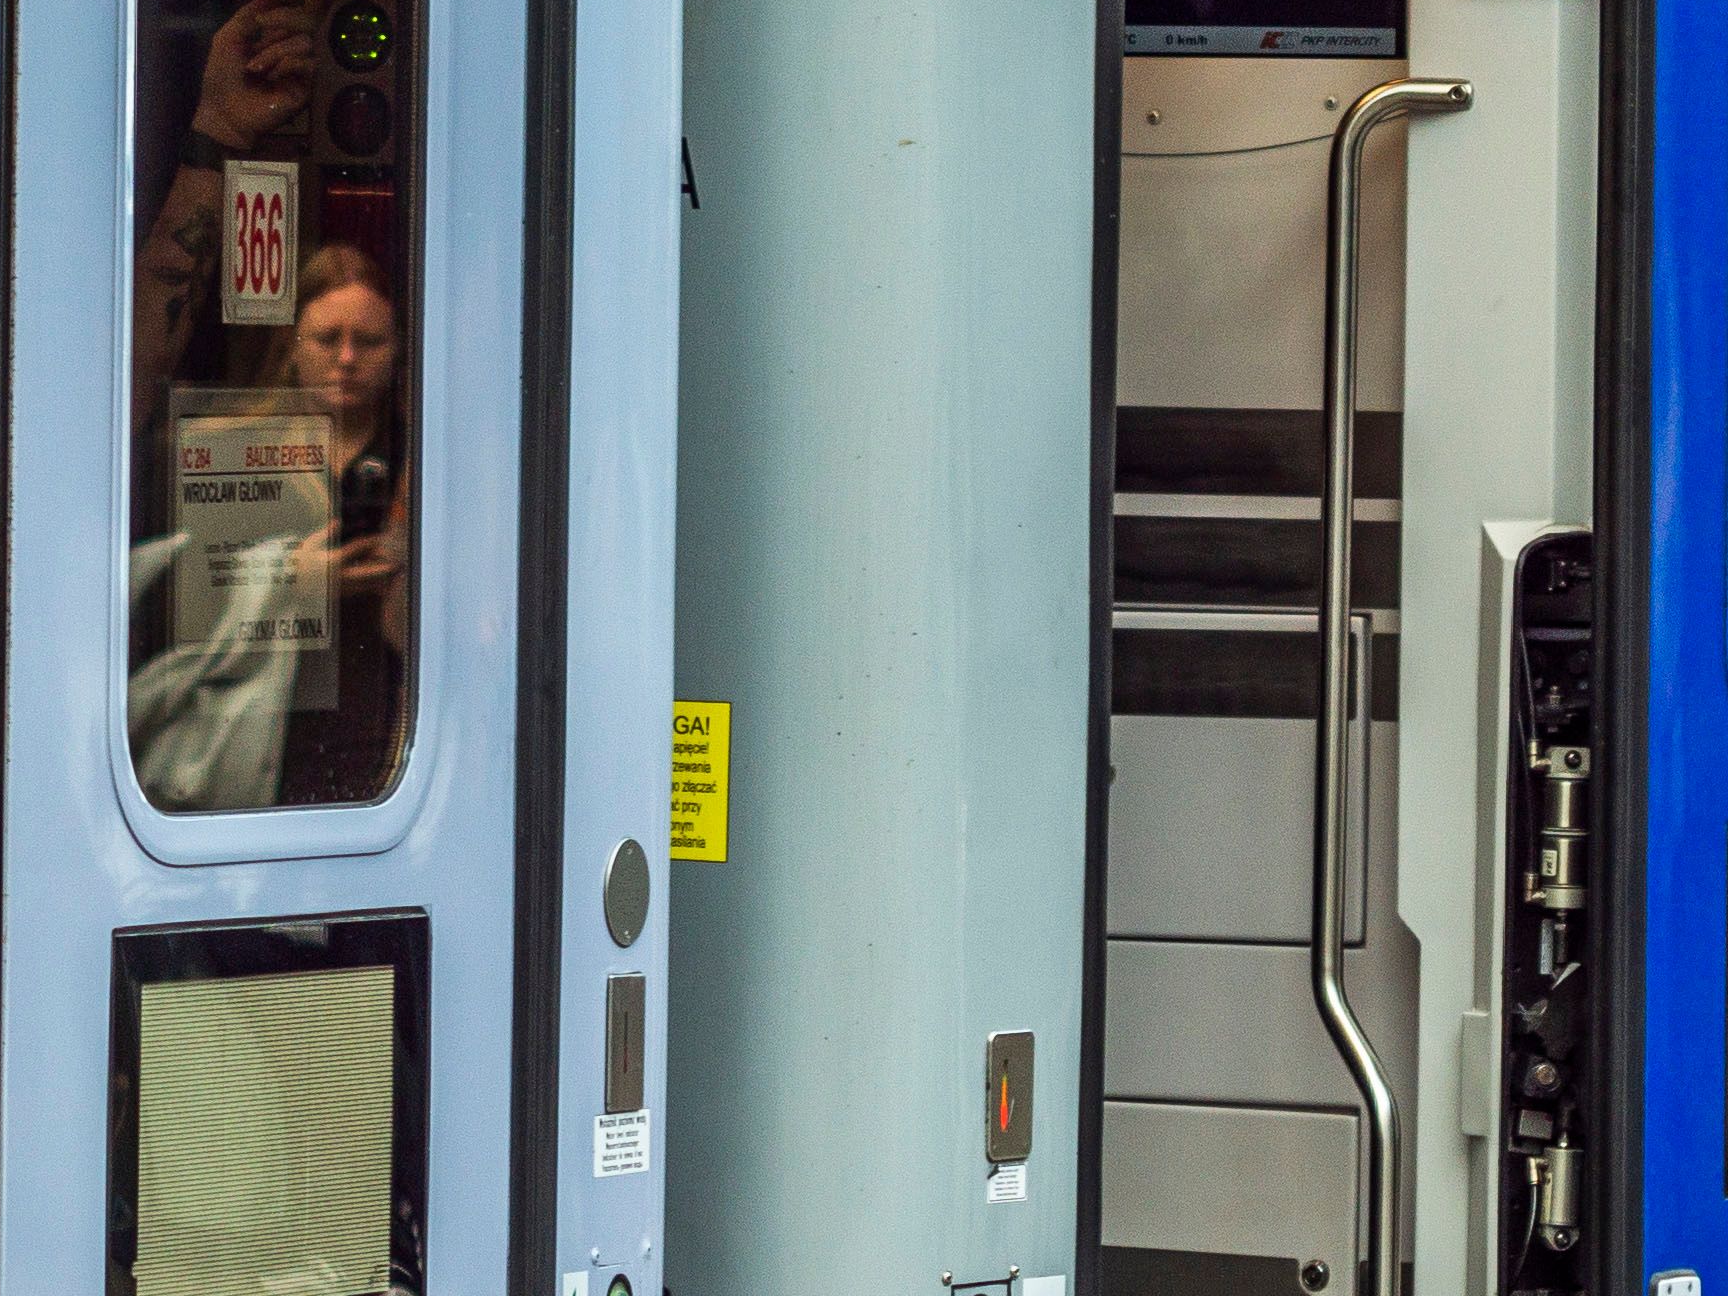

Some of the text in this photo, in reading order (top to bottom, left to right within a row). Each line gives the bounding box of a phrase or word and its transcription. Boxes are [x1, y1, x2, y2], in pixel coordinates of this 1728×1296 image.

[1178, 34, 1208, 46] km/h
[1300, 35, 1325, 46] PKP
[1326, 35, 1381, 47] INTERCITY
[234, 191, 283, 295] 366
[245, 445, 280, 467] BALTIC
[281, 444, 324, 466] EXPRESS
[673, 715, 710, 736] GA!
[682, 803, 701, 816] przy
